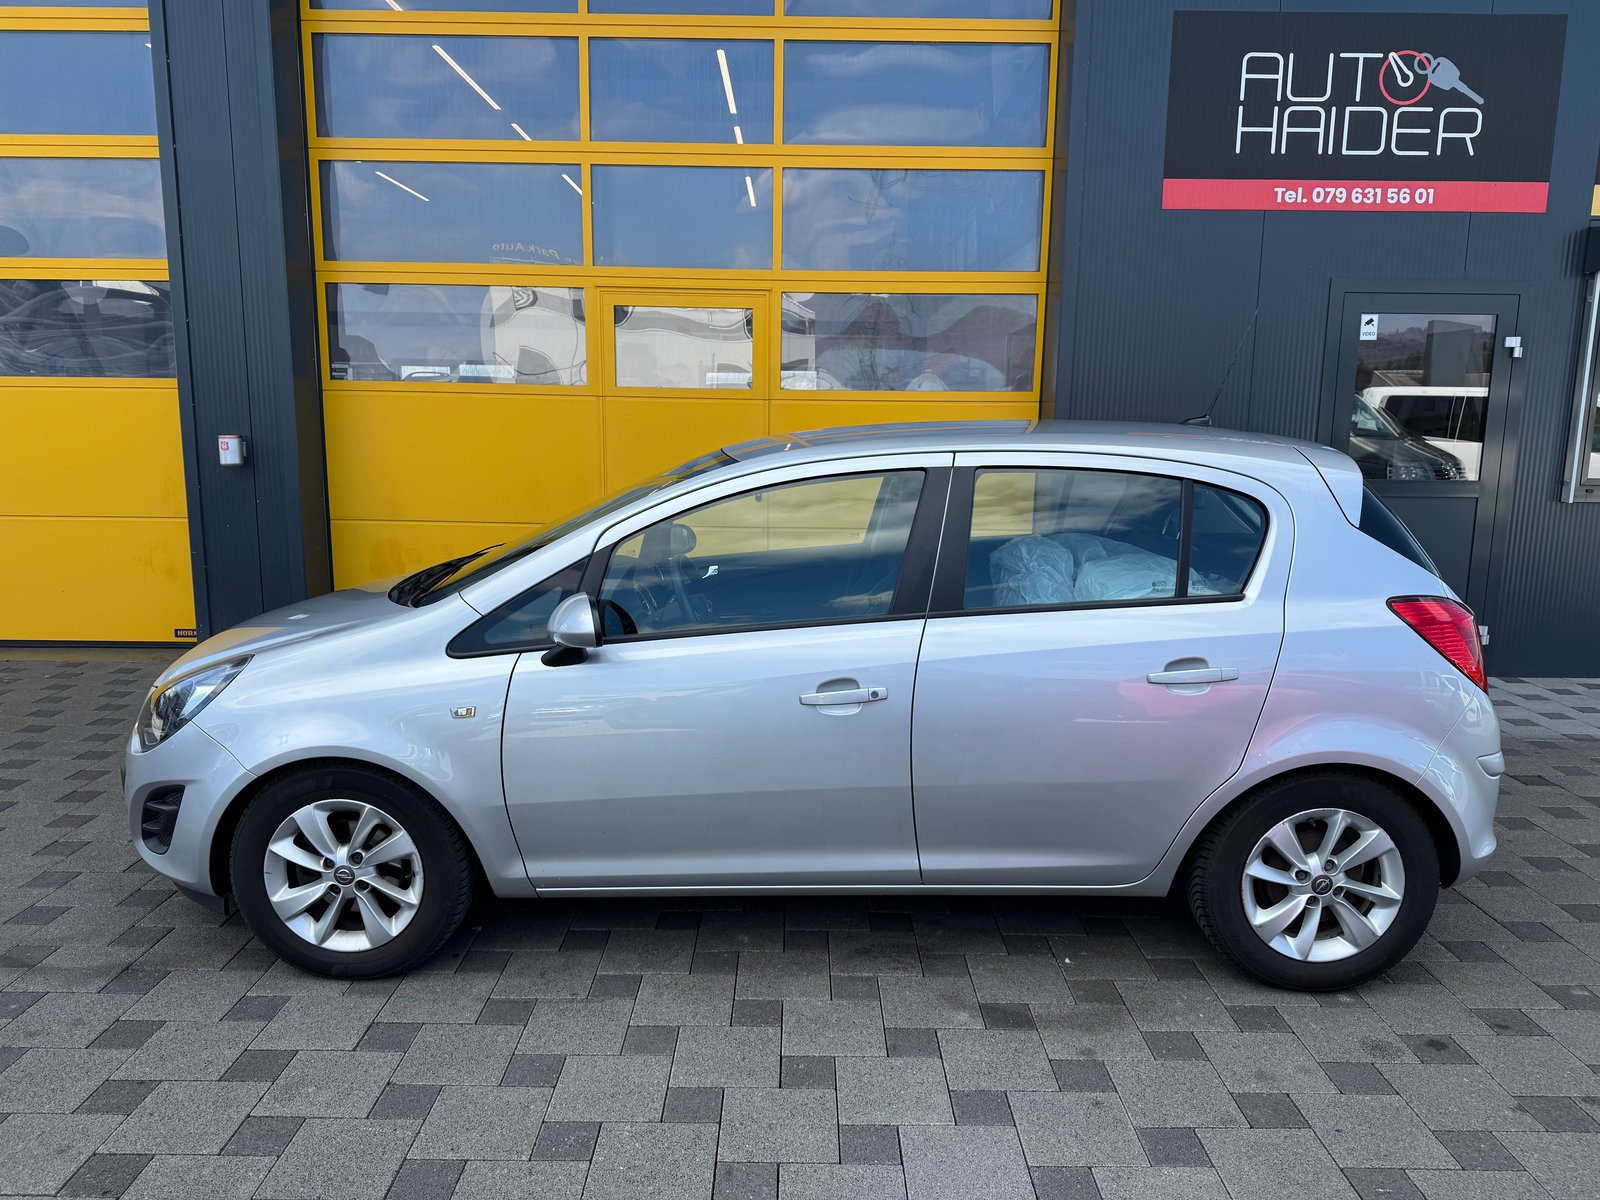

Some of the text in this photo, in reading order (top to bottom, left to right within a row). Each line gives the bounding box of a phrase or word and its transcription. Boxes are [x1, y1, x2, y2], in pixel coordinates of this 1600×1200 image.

[1240, 50, 1432, 106] AUTO
[1235, 105, 1483, 156] HAIDER
[1274, 187, 1434, 204] Tel. 079 631 56 01
